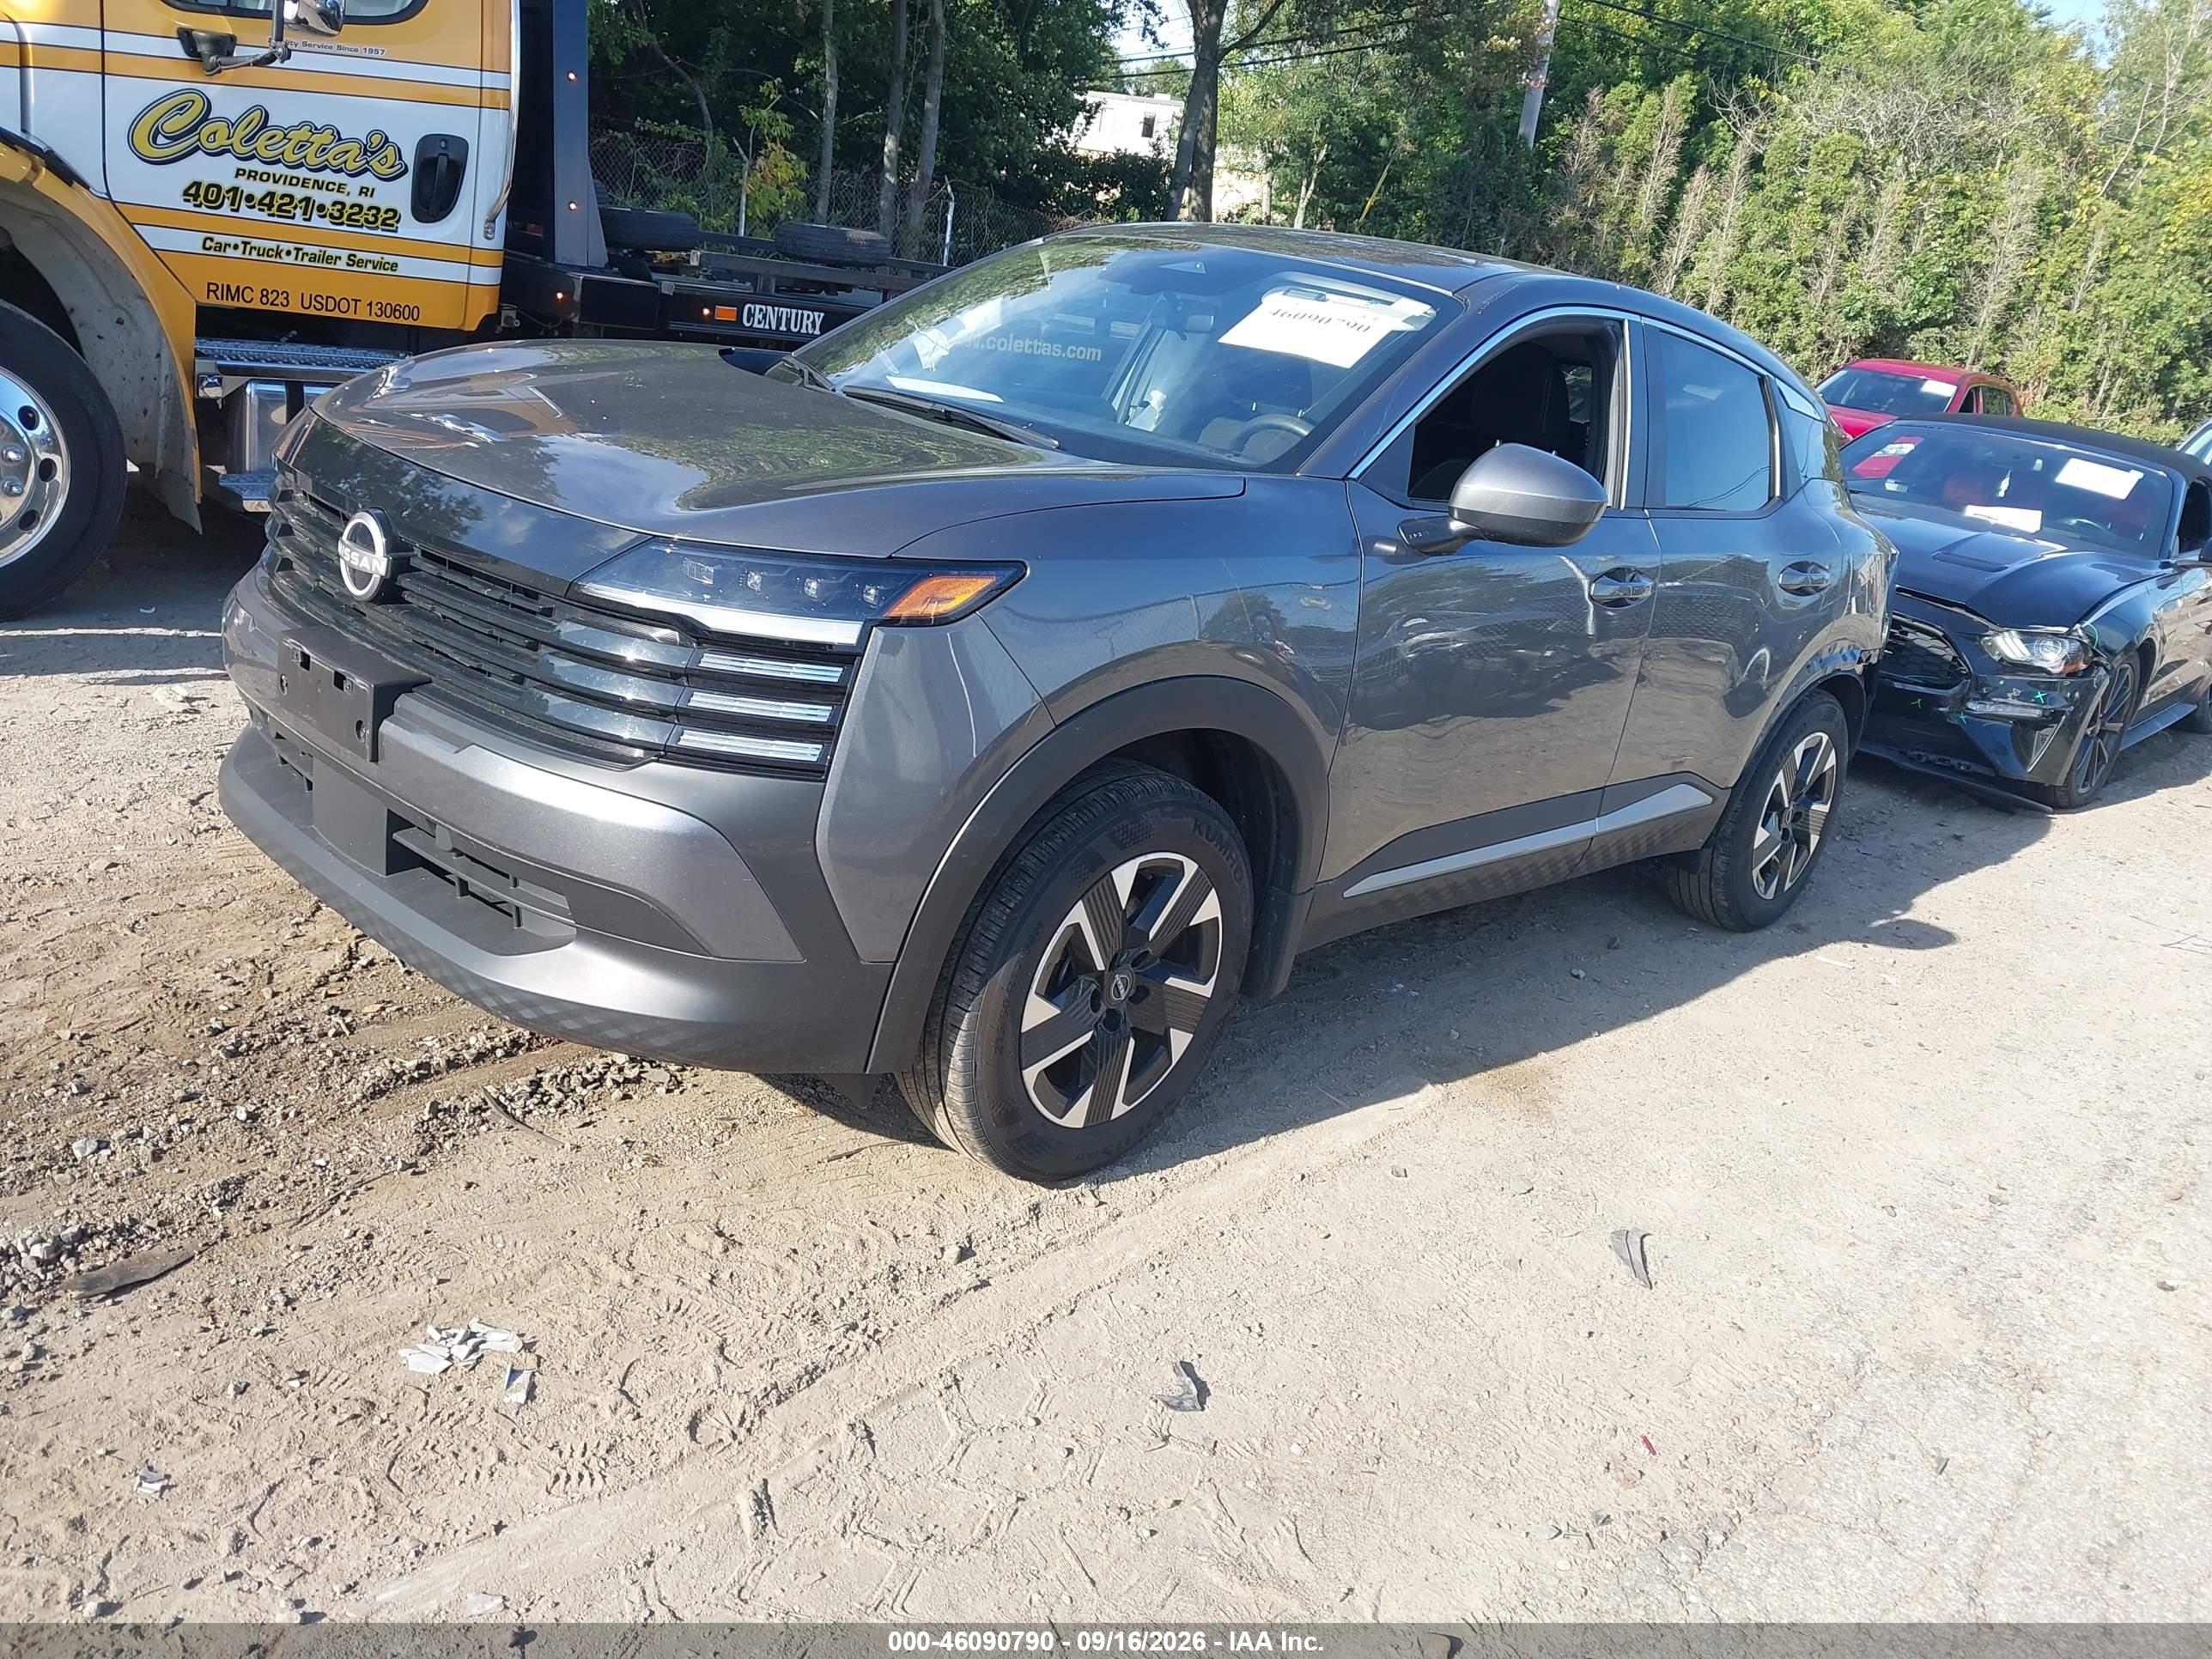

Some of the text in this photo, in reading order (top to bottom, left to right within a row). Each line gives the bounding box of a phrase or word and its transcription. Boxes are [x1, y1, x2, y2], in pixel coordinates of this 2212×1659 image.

[301, 40, 333, 51] Service
[336, 44, 359, 53] Since
[362, 47, 386, 56] 1957
[128, 88, 409, 181] Coletta's
[234, 167, 376, 198] PROVIDENCE, RI
[346, 253, 399, 272] Service
[206, 282, 420, 321] RIMC 823 USDOT 130600
[742, 303, 825, 335] CENTURY
[338, 539, 386, 575] NISSAN
